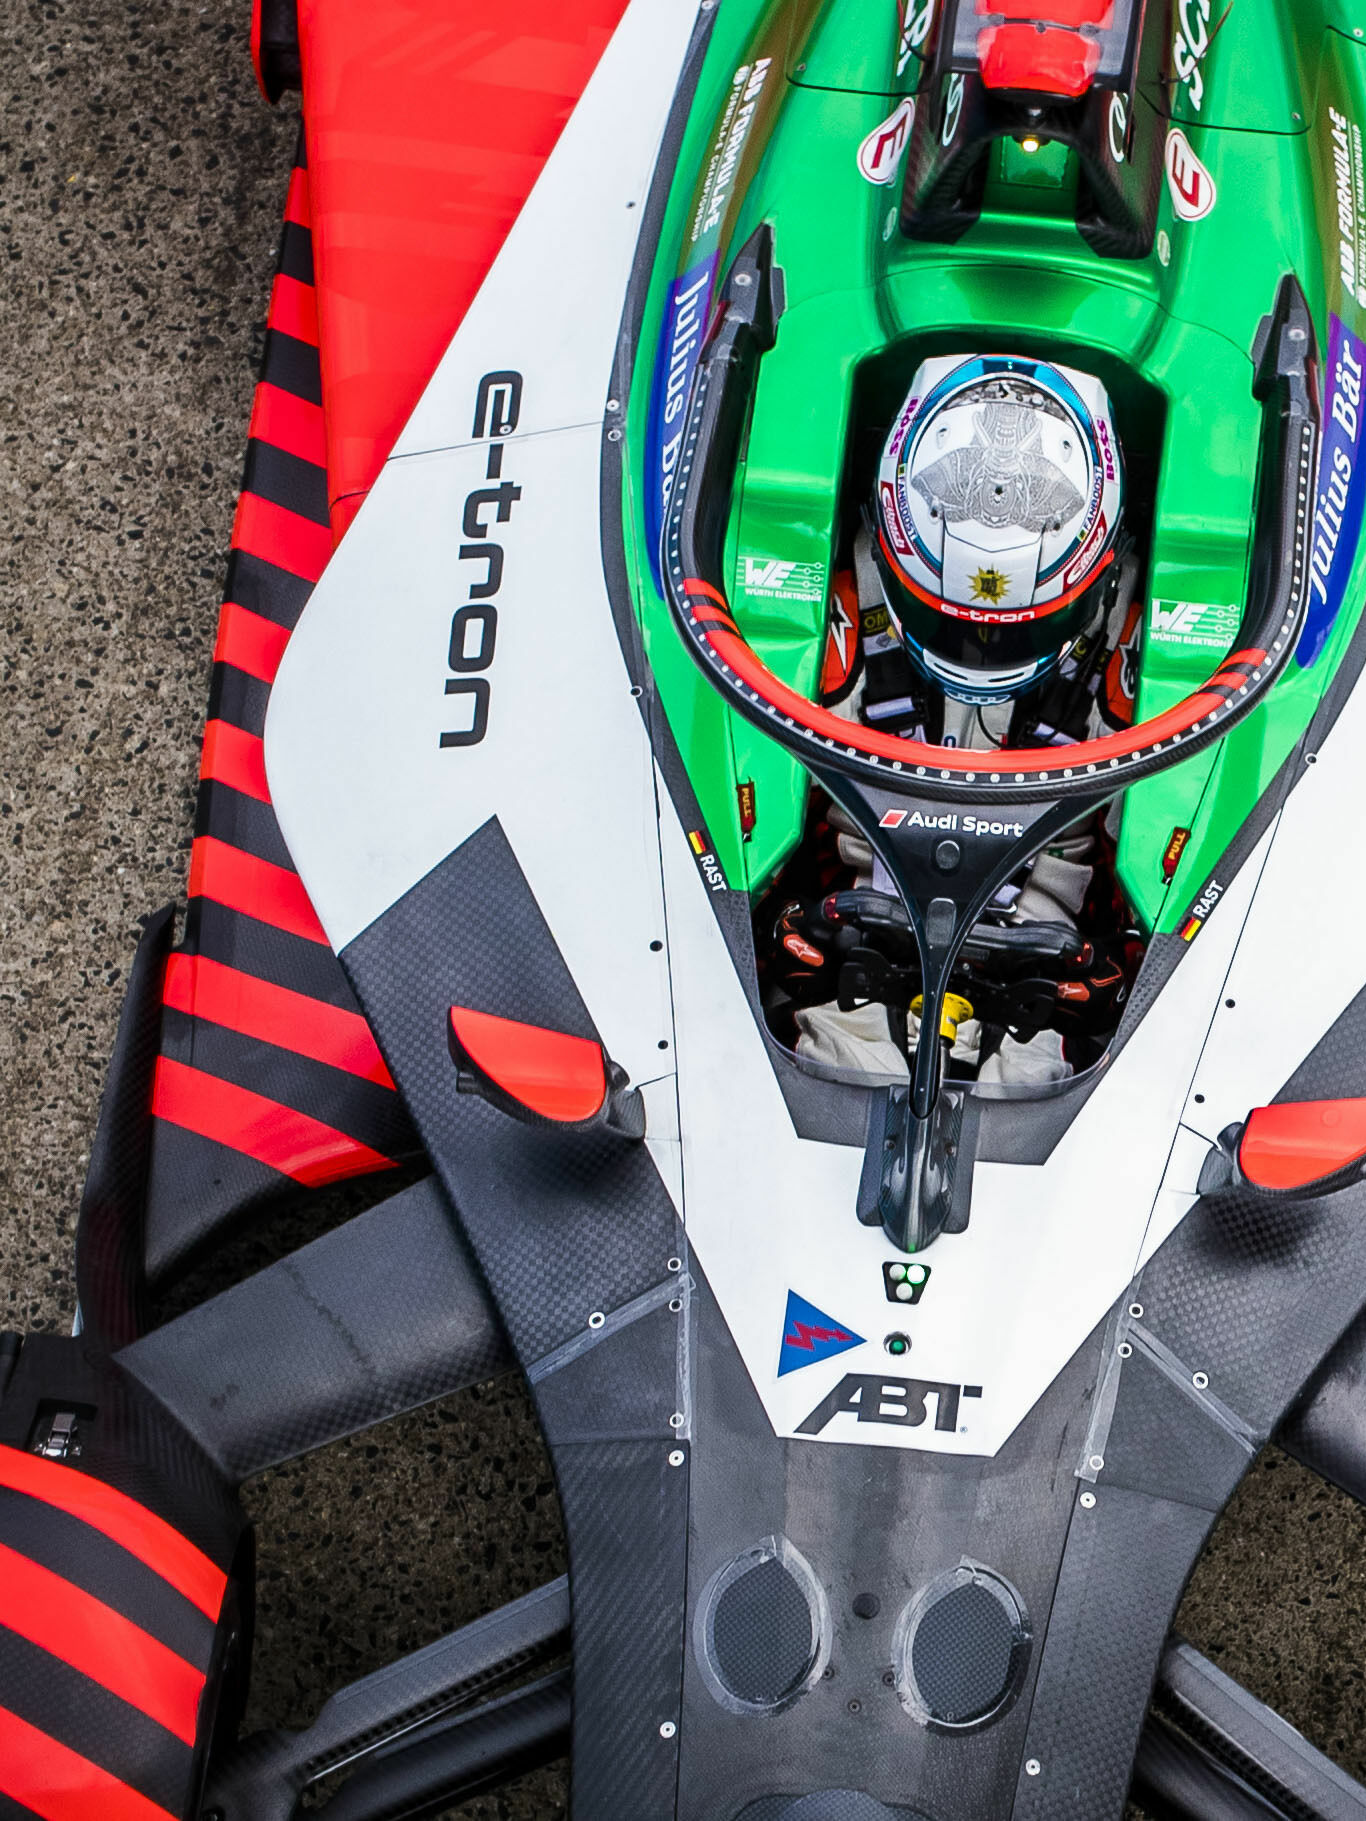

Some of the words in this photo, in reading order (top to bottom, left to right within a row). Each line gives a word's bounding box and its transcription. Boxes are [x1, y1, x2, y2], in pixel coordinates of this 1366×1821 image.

[664, 271, 709, 424] Julius
[890, 398, 919, 456] BOSS
[1096, 418, 1114, 481] BOSS
[1310, 447, 1351, 605] Julius
[1332, 339, 1362, 443] Bär
[898, 475, 917, 541] FANBOOST
[1084, 466, 1103, 531] FANBOOST
[439, 370, 524, 749] e-tron
[745, 557, 797, 588] WE
[941, 603, 1035, 622] e-tron
[1151, 599, 1209, 632] WE
[741, 787, 751, 818] PULL
[907, 811, 957, 830] Audi
[962, 816, 1024, 838] Sport
[1168, 832, 1186, 860] PULL
[700, 854, 727, 891] RAST
[1192, 880, 1224, 918] RAST
[793, 1373, 983, 1435] ABT
